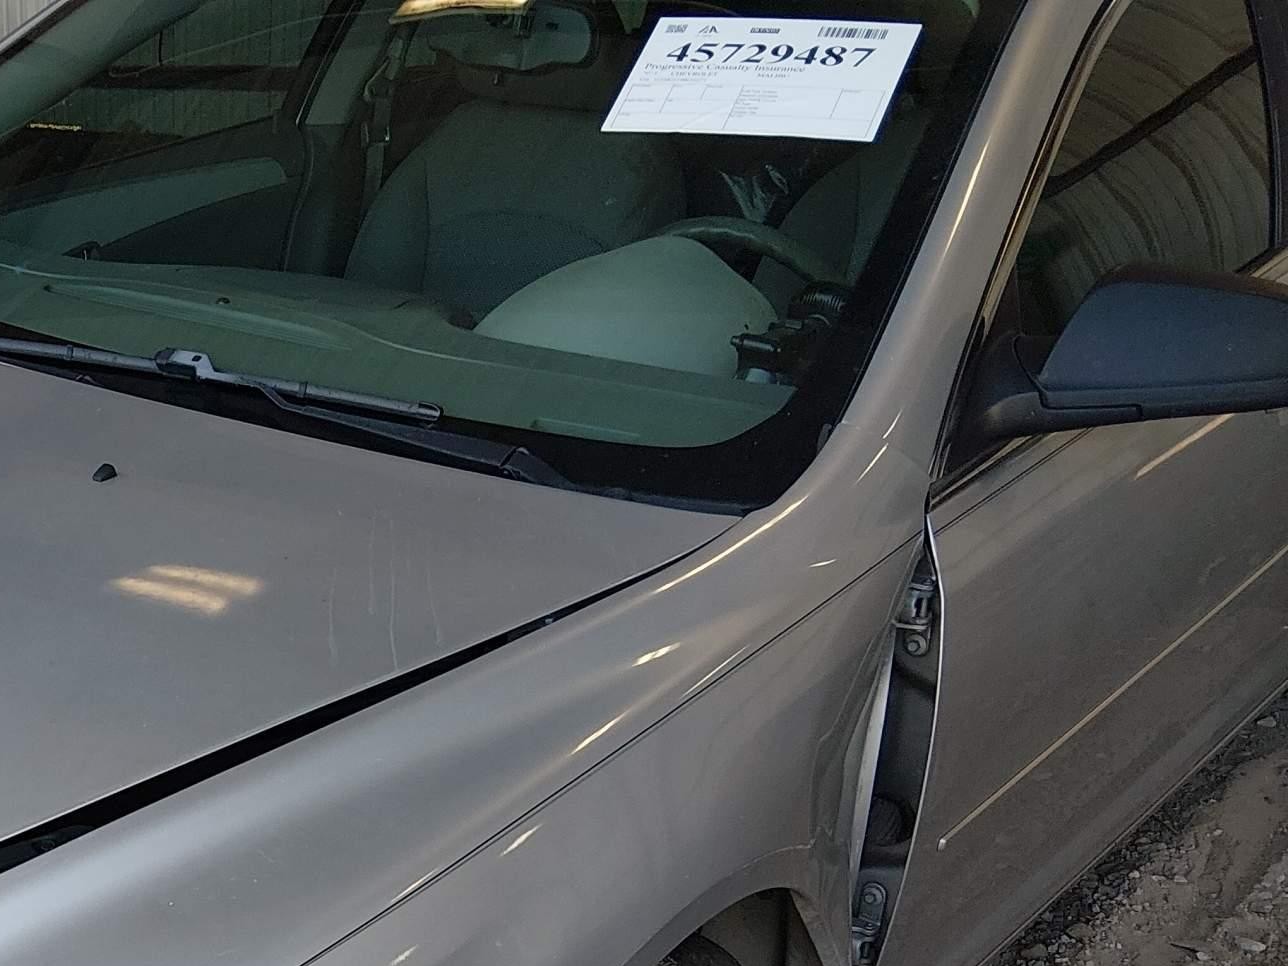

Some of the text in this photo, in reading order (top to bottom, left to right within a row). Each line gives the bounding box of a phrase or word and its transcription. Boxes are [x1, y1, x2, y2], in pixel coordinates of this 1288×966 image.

[666, 41, 877, 68] 45729487
[644, 62, 806, 73] Progressive Casualty Insurance
